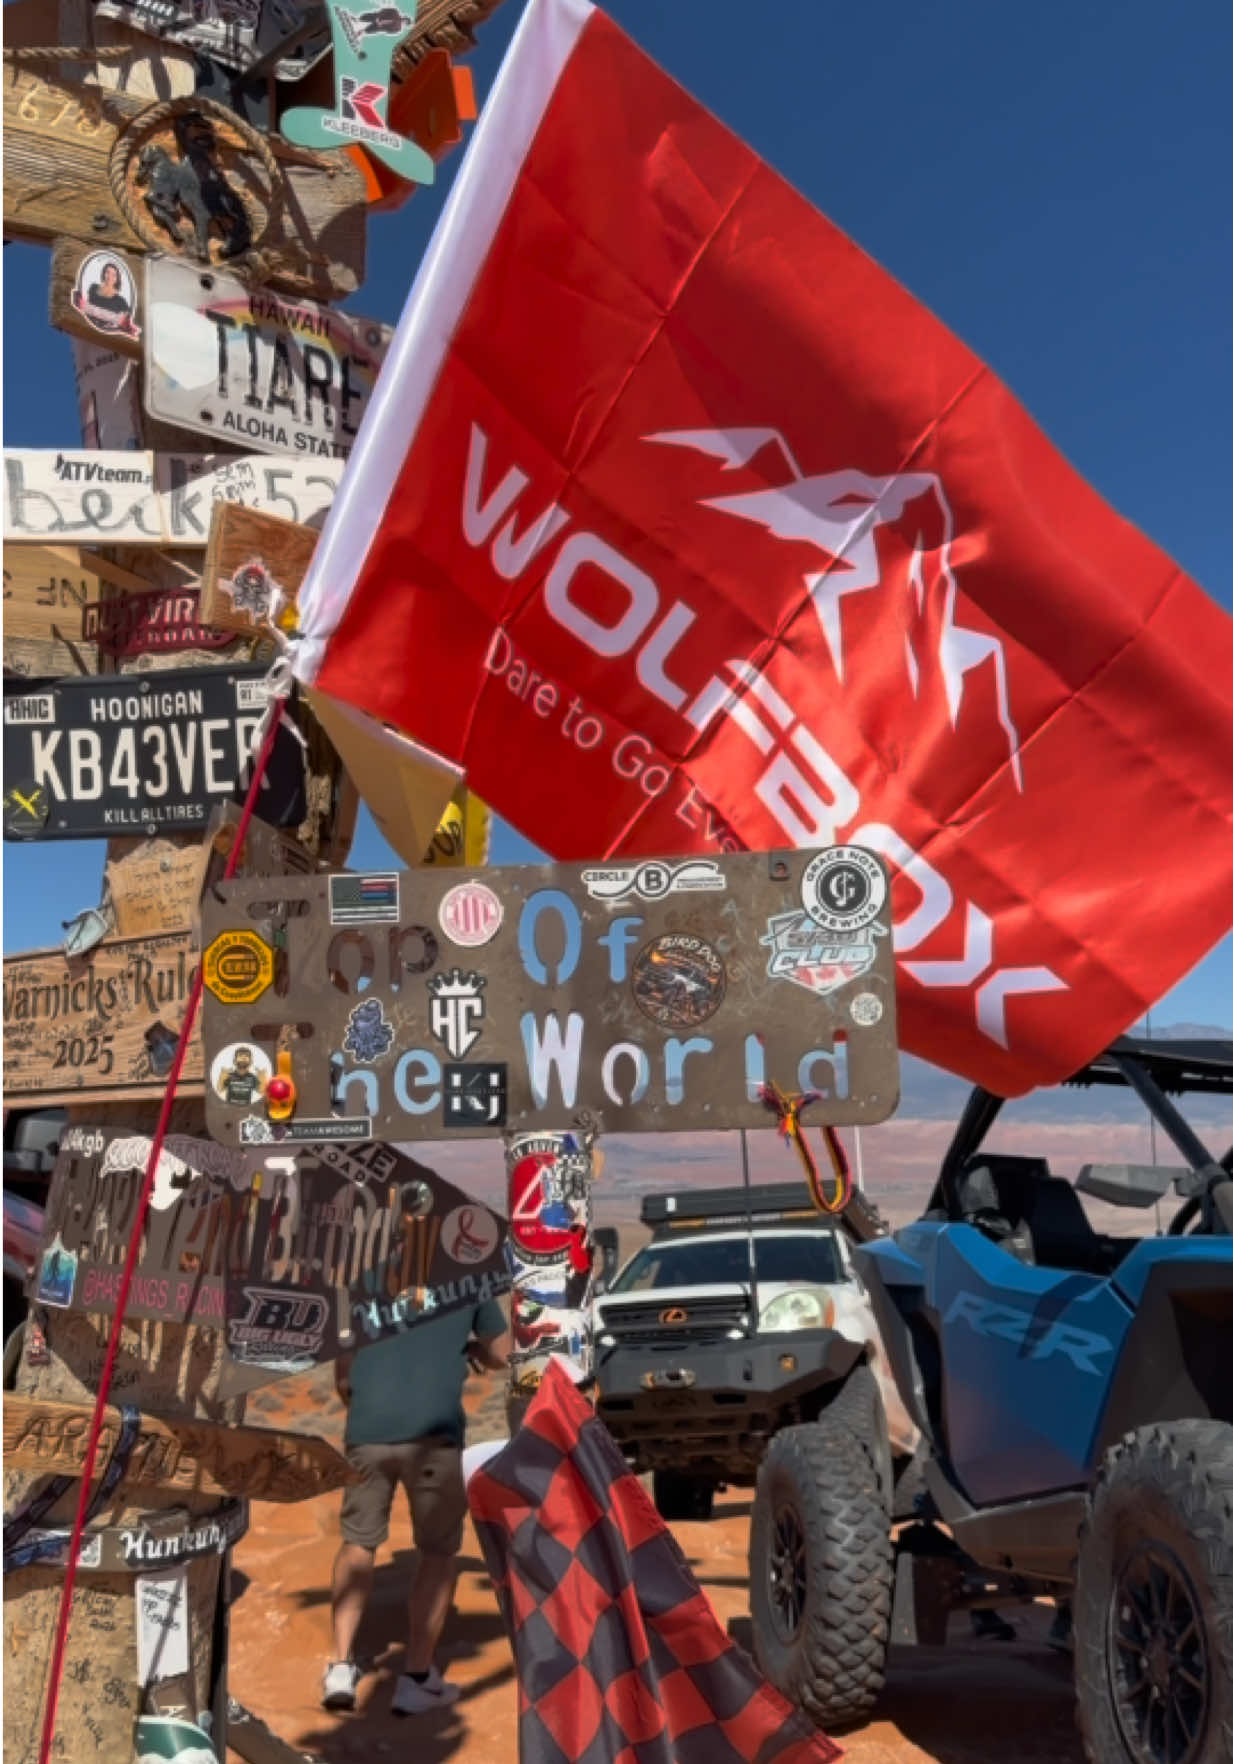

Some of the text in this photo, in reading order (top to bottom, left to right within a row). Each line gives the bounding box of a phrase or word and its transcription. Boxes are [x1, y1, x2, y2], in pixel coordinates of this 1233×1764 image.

[323, 118, 400, 148] KLEEBERG
[206, 309, 369, 435] TIARE
[223, 412, 289, 447] ALOHA
[90, 689, 204, 724] HOONIGAN
[462, 421, 1069, 1050] WOLFBOX
[482, 628, 559, 718] Dare
[561, 695, 604, 751] to
[610, 734, 670, 797] Go
[806, 850, 881, 882] GRACE NOTE
[246, 898, 439, 998] Top
[518, 889, 645, 985] Of
[811, 903, 878, 928] BREWING
[52, 1033, 115, 1076] 2025
[432, 997, 482, 1058] HC
[519, 1010, 849, 1110] World
[943, 1290, 1114, 1377] RZR
